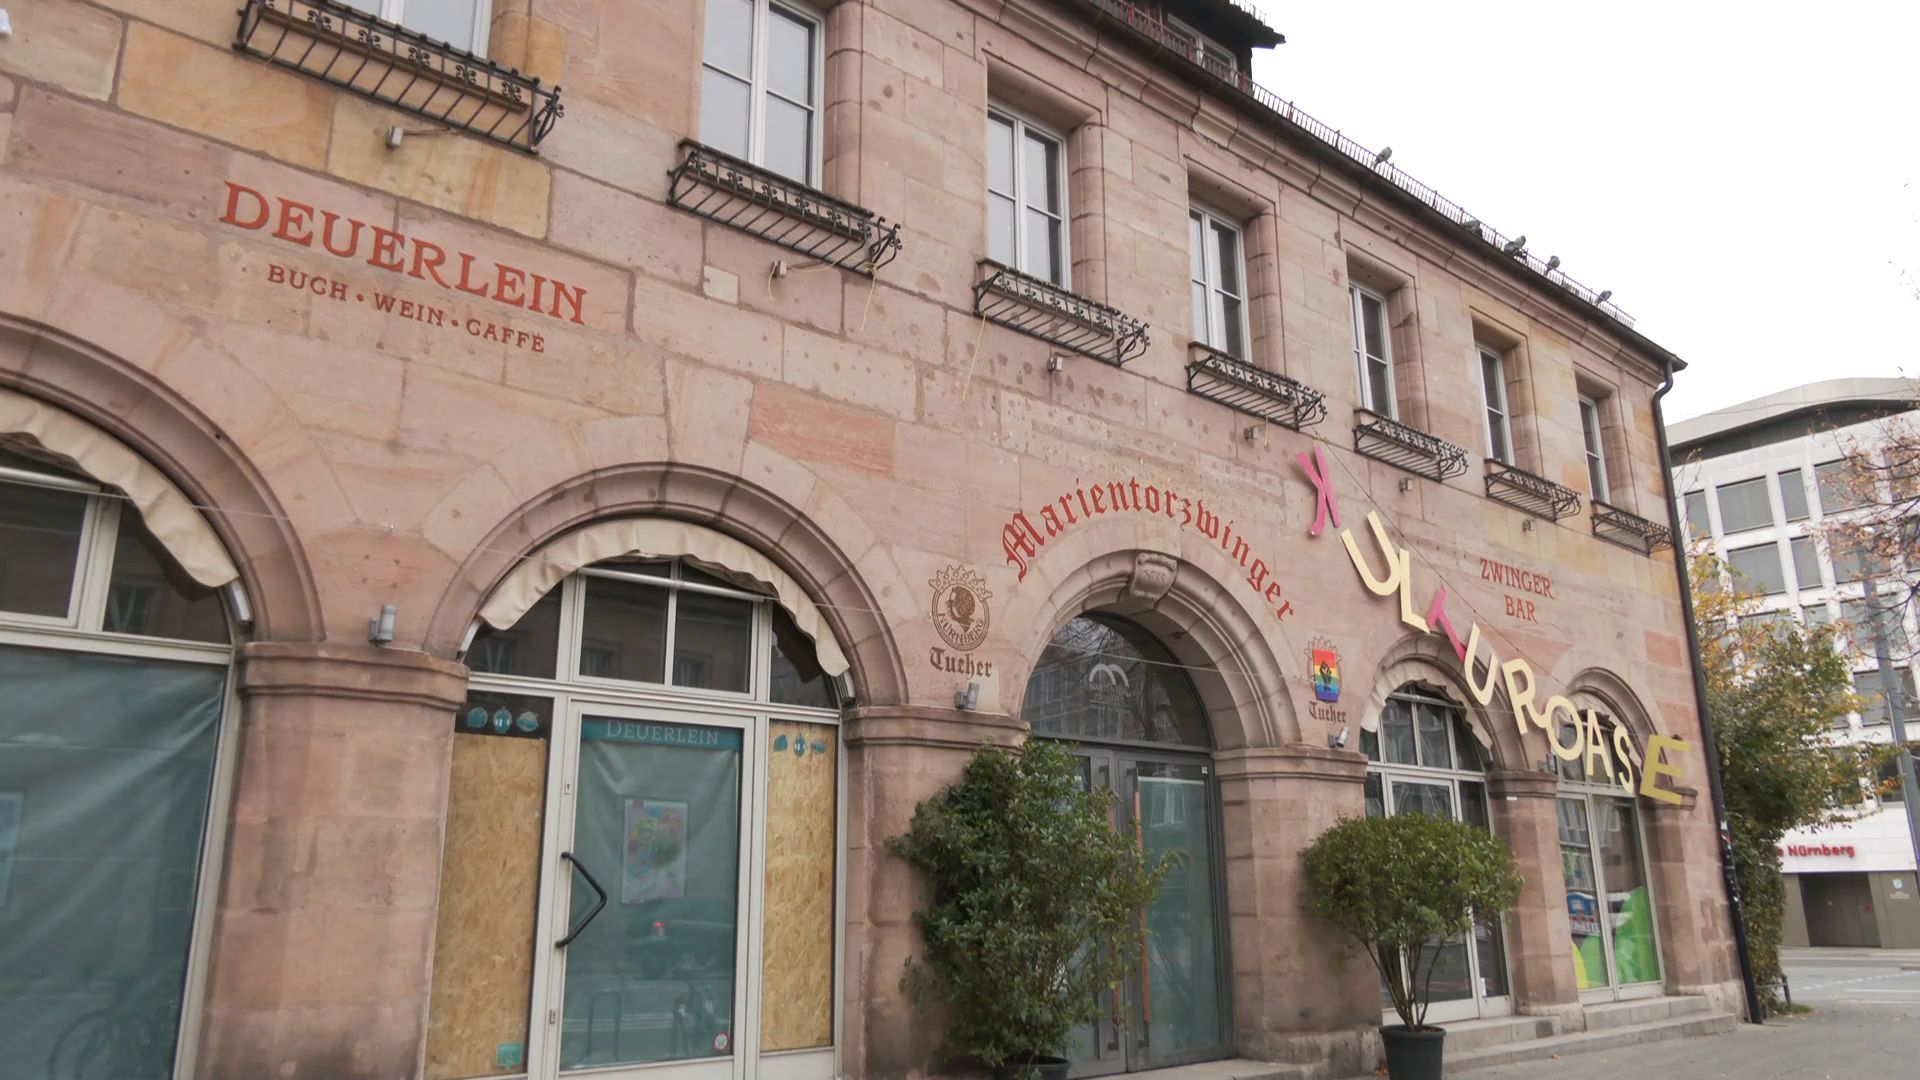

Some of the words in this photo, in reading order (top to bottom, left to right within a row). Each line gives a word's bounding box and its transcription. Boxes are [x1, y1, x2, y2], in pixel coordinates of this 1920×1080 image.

[219, 180, 588, 326] DEUERLEIN
[267, 263, 349, 301] BUCH
[373, 292, 443, 327] WEIN
[1001, 475, 1294, 622] Marientorzwinger
[1480, 556, 1555, 600] ZWINGER
[1504, 593, 1539, 624] BAR
[929, 646, 993, 680] Tucher
[606, 719, 719, 745] DEUERLEIN
[1308, 700, 1348, 725] Tucher
